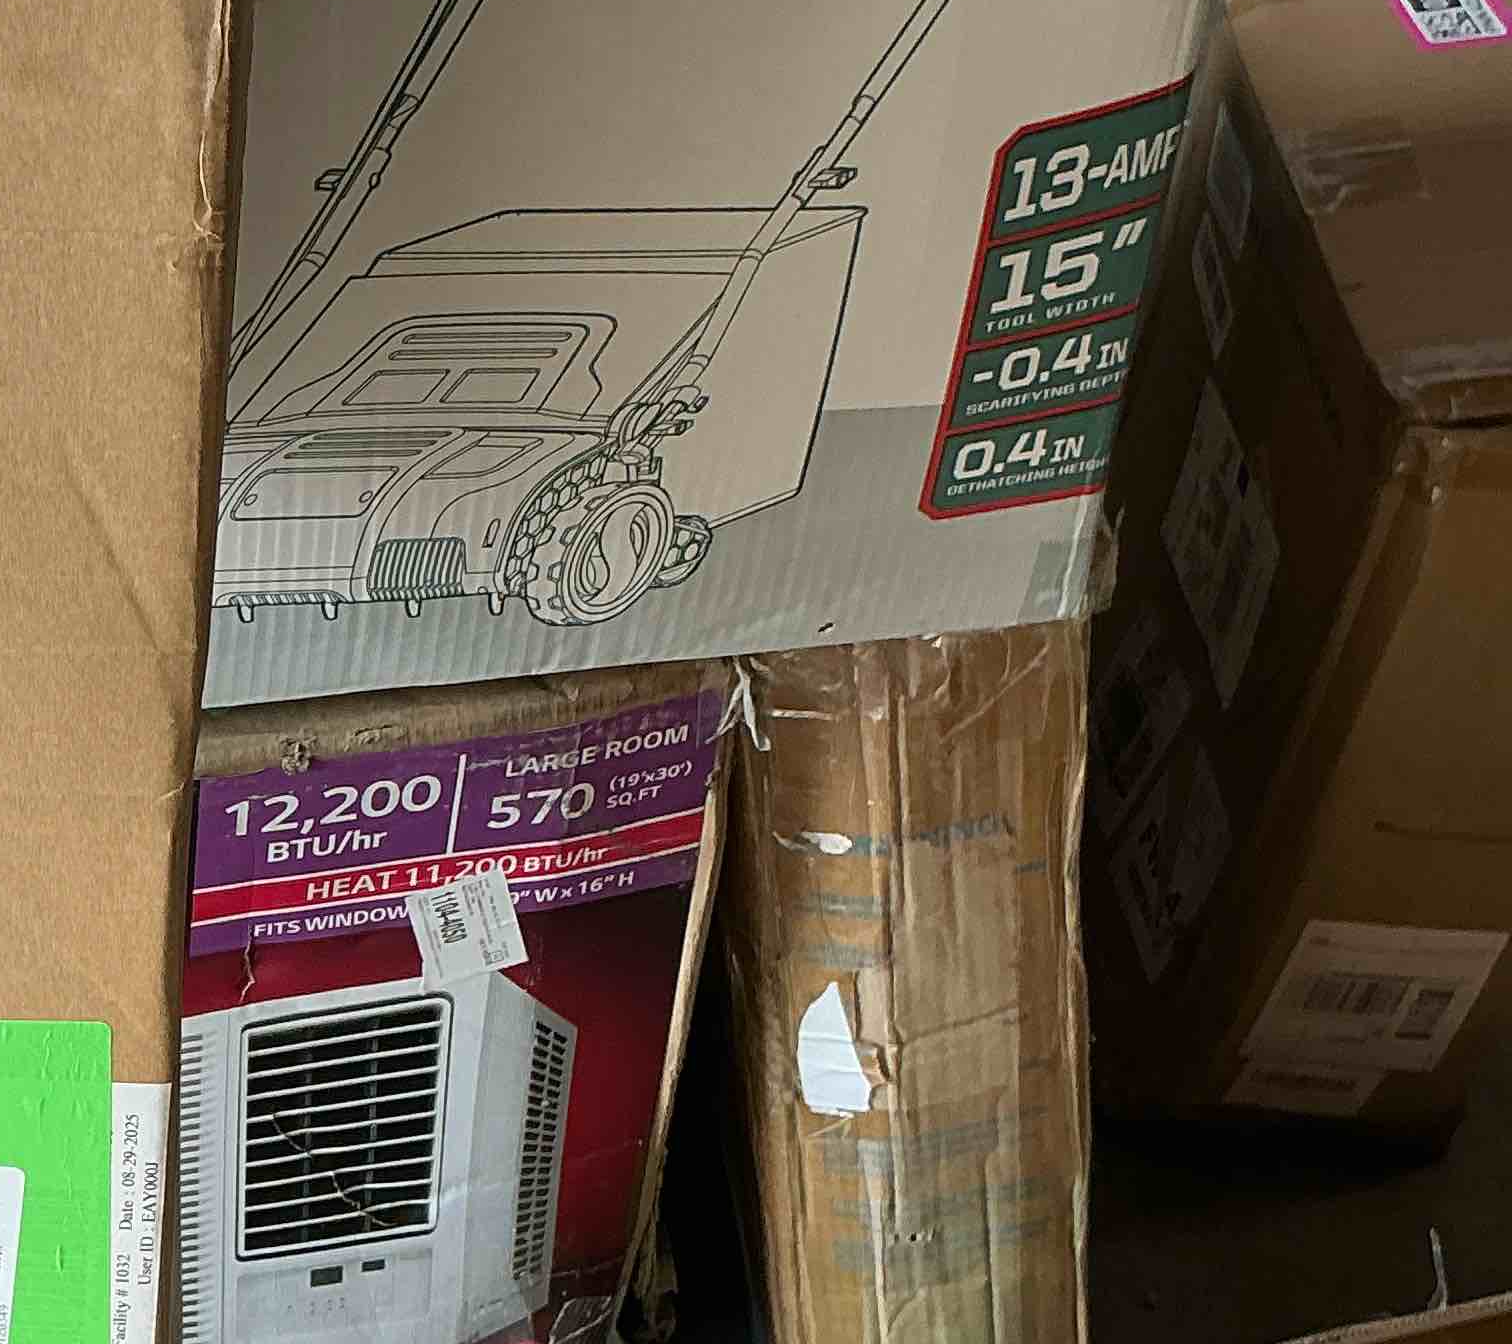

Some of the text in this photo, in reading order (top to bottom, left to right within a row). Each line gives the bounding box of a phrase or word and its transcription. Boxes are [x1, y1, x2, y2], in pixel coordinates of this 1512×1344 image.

[989, 217, 1148, 315] 15"
[985, 291, 1116, 334] TOOL WIDTH
[973, 333, 1129, 391] -0.4 IN
[965, 384, 1076, 416] SCARIFYING
[953, 428, 1085, 481] 0.4 IN
[946, 467, 1056, 496] DETHATCHING
[505, 724, 689, 778] LARGE ROOM
[224, 774, 442, 838] 12,200
[488, 782, 596, 830] 570
[605, 784, 664, 811] SQ.FT
[266, 830, 388, 864] BTU/hr
[306, 870, 394, 902] HEAT
[522, 844, 610, 874] BTU/hr
[534, 885, 558, 904] W
[577, 874, 614, 896] 16"
[617, 870, 634, 888] H
[252, 920, 302, 939] FITS
[122, 1114, 139, 1187] 08-29-2025
[119, 1200, 134, 1231] Date
[138, 1162, 160, 1285] User ID EAY000J
[115, 1254, 130, 1283] 1032
